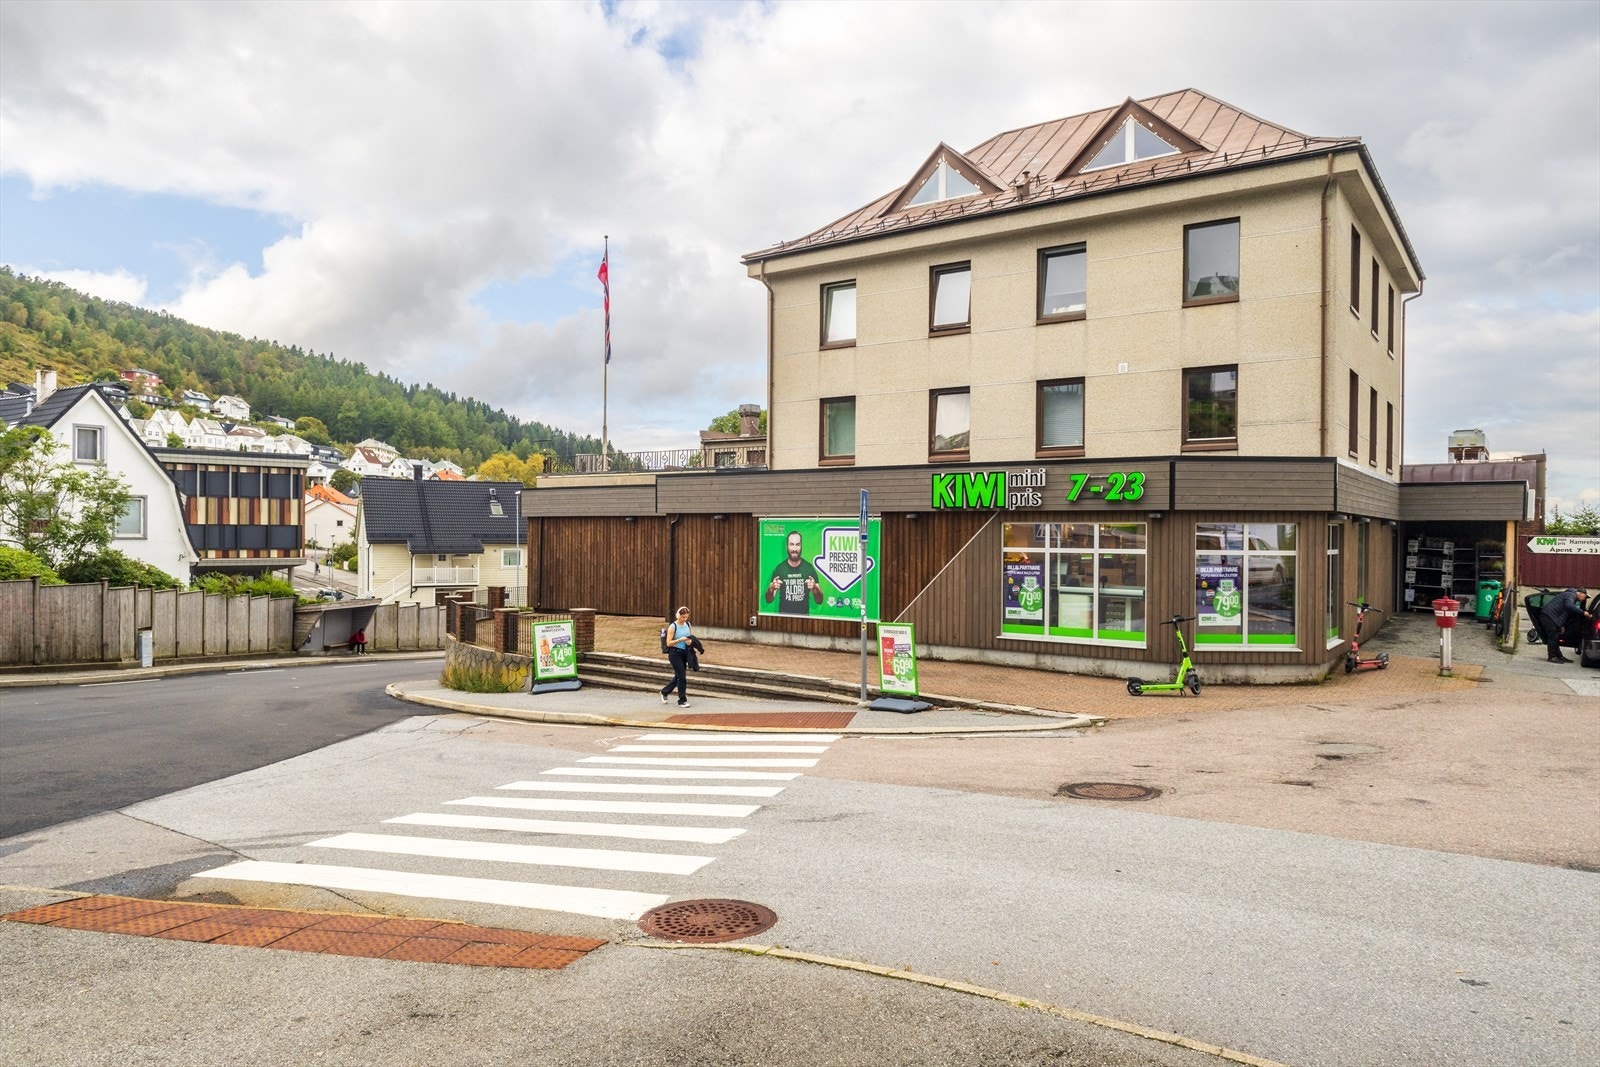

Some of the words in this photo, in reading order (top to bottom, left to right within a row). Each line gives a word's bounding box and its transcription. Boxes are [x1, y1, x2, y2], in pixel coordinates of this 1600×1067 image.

[1009, 468, 1046, 487] mini
[931, 471, 1008, 509] KIWI
[1009, 488, 1042, 510] pris
[829, 536, 858, 551] KIWI
[829, 552, 858, 562] PRESSER
[829, 562, 858, 573] PRISENE!
[785, 585, 805, 595] ALDRI
